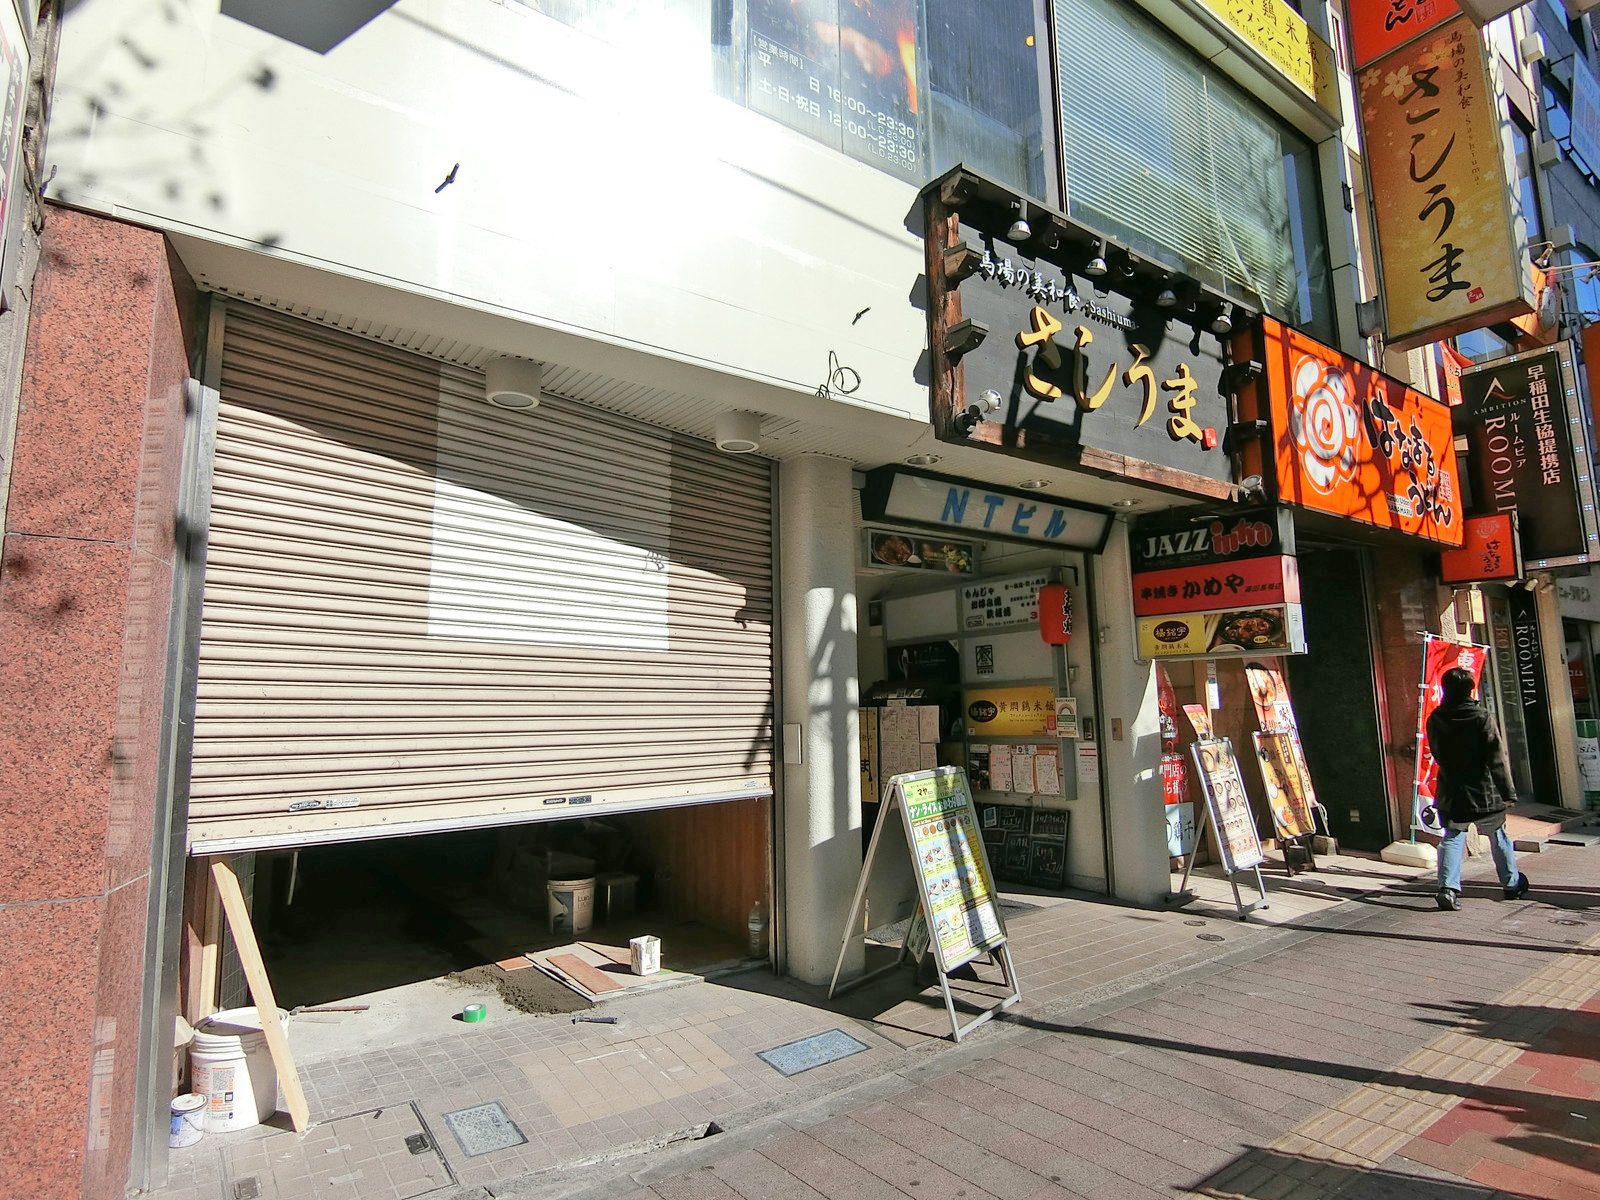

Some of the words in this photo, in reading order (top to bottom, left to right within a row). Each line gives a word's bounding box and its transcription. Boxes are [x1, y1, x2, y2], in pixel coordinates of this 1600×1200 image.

[1450, 31, 1474, 110] 馬場の美和食
[1398, 65, 1472, 302] さしうま
[979, 250, 1081, 311] 馬場の美和食
[1015, 306, 1204, 443] さしうま
[1362, 387, 1436, 478] はなまる
[1473, 398, 1528, 416] AMBITION
[1527, 364, 1561, 486] 早稲田生協提携店
[1509, 411, 1526, 469] ルームピア
[940, 487, 1068, 539] NTビル
[1407, 471, 1452, 528] うどん
[1142, 528, 1213, 559] JAZZ
[964, 587, 995, 598] もんじゃ
[1182, 573, 1245, 600] かめや
[1515, 625, 1538, 706] ROOMPIA
